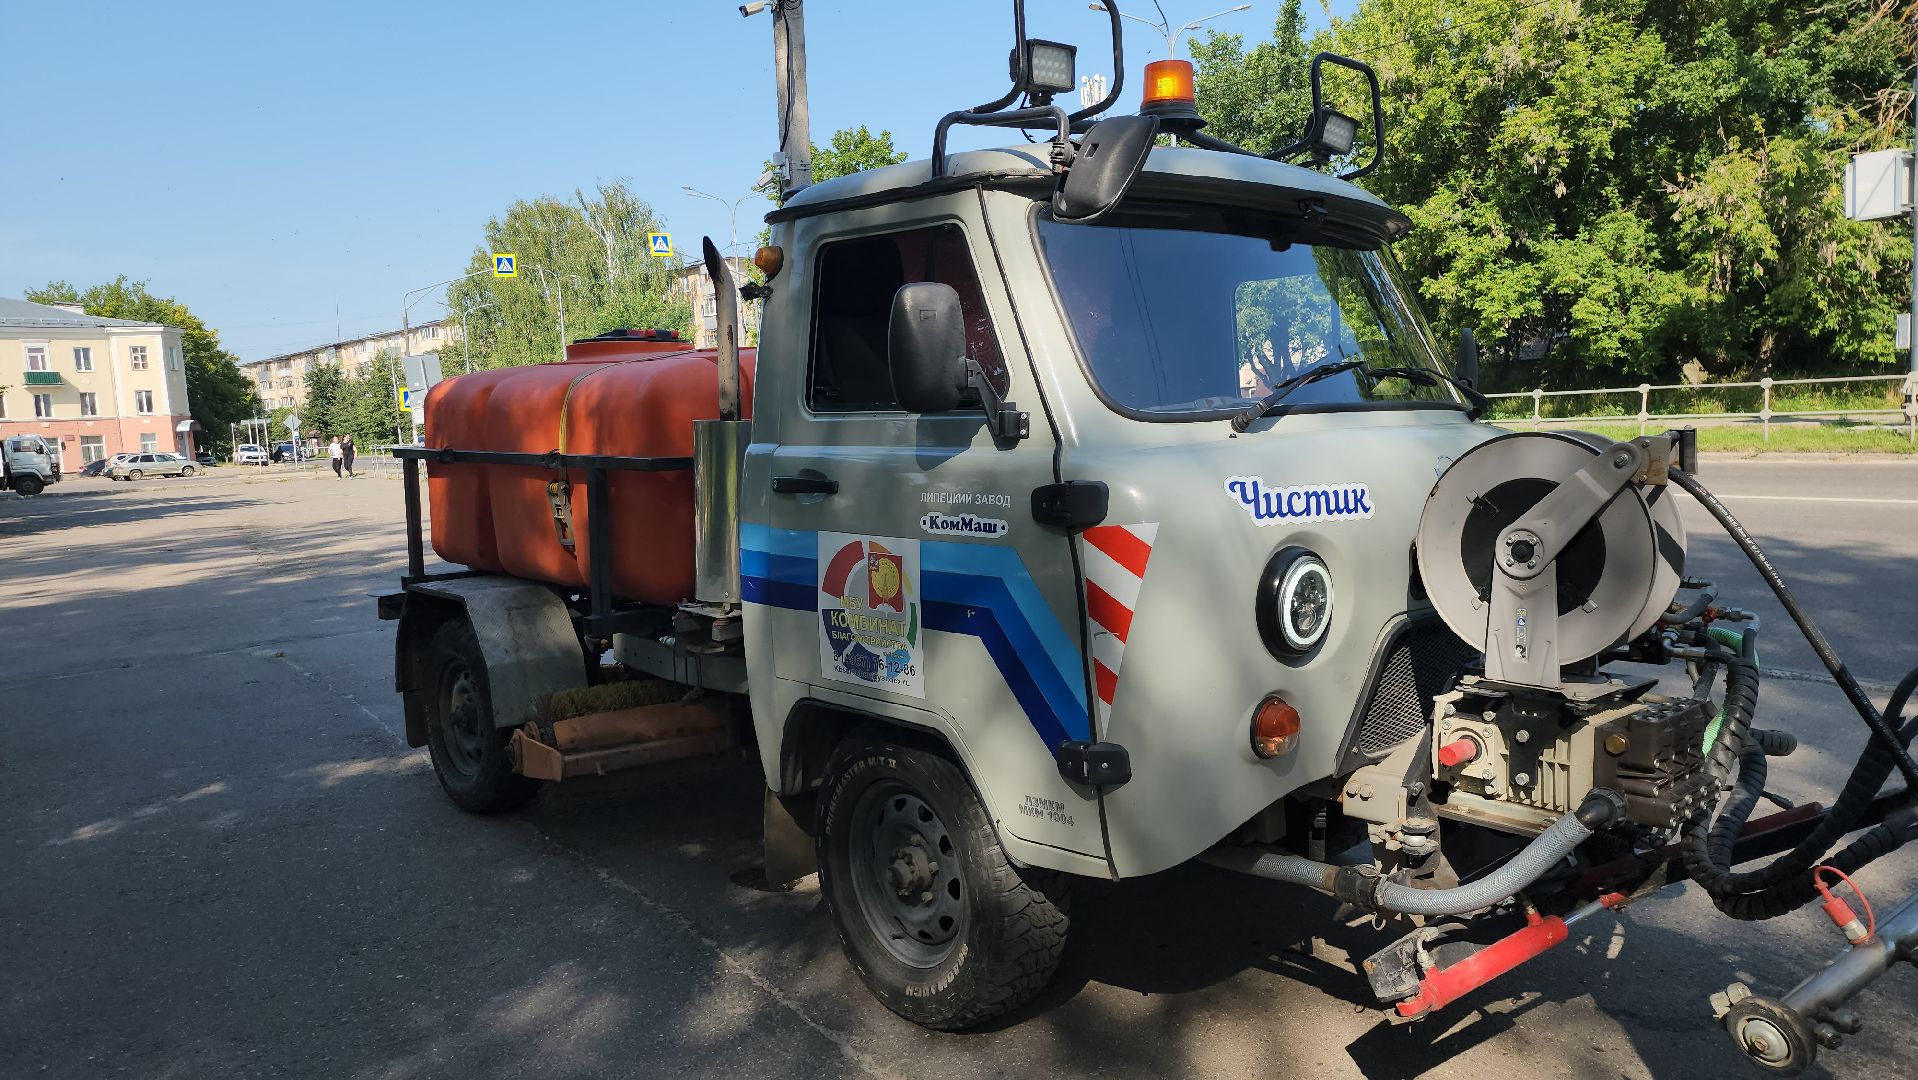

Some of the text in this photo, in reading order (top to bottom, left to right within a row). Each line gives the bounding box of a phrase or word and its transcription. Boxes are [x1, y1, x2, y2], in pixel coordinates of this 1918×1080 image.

[920, 491, 1011, 509] ЛИПЕЦКИЙ ЗАВОД
[1229, 480, 1371, 520] Чистик
[840, 595, 863, 610] МБУ
[831, 610, 906, 638] КОМБИНАТ
